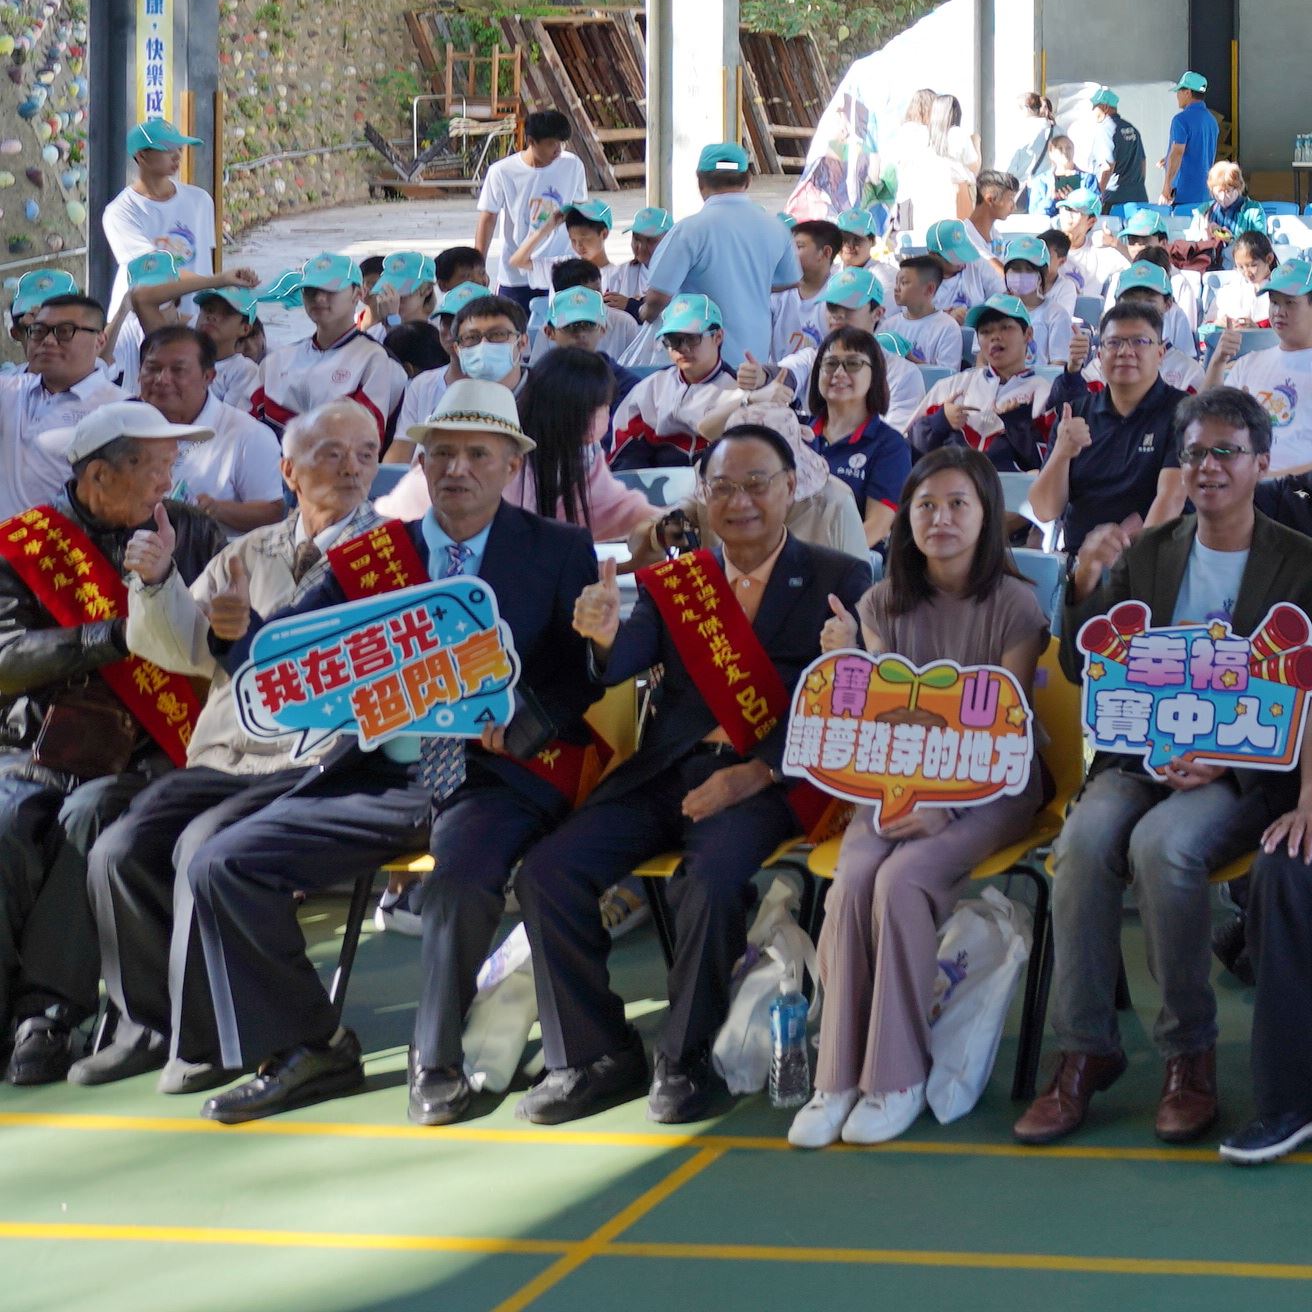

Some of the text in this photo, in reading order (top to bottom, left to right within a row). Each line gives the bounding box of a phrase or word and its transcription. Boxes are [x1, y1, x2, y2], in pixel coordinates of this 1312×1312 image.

[255, 607, 439, 714] 我在莒光
[351, 630, 511, 741] 超閃亮
[1126, 634, 1250, 691] 幸福
[1095, 689, 1277, 749] 寶中人
